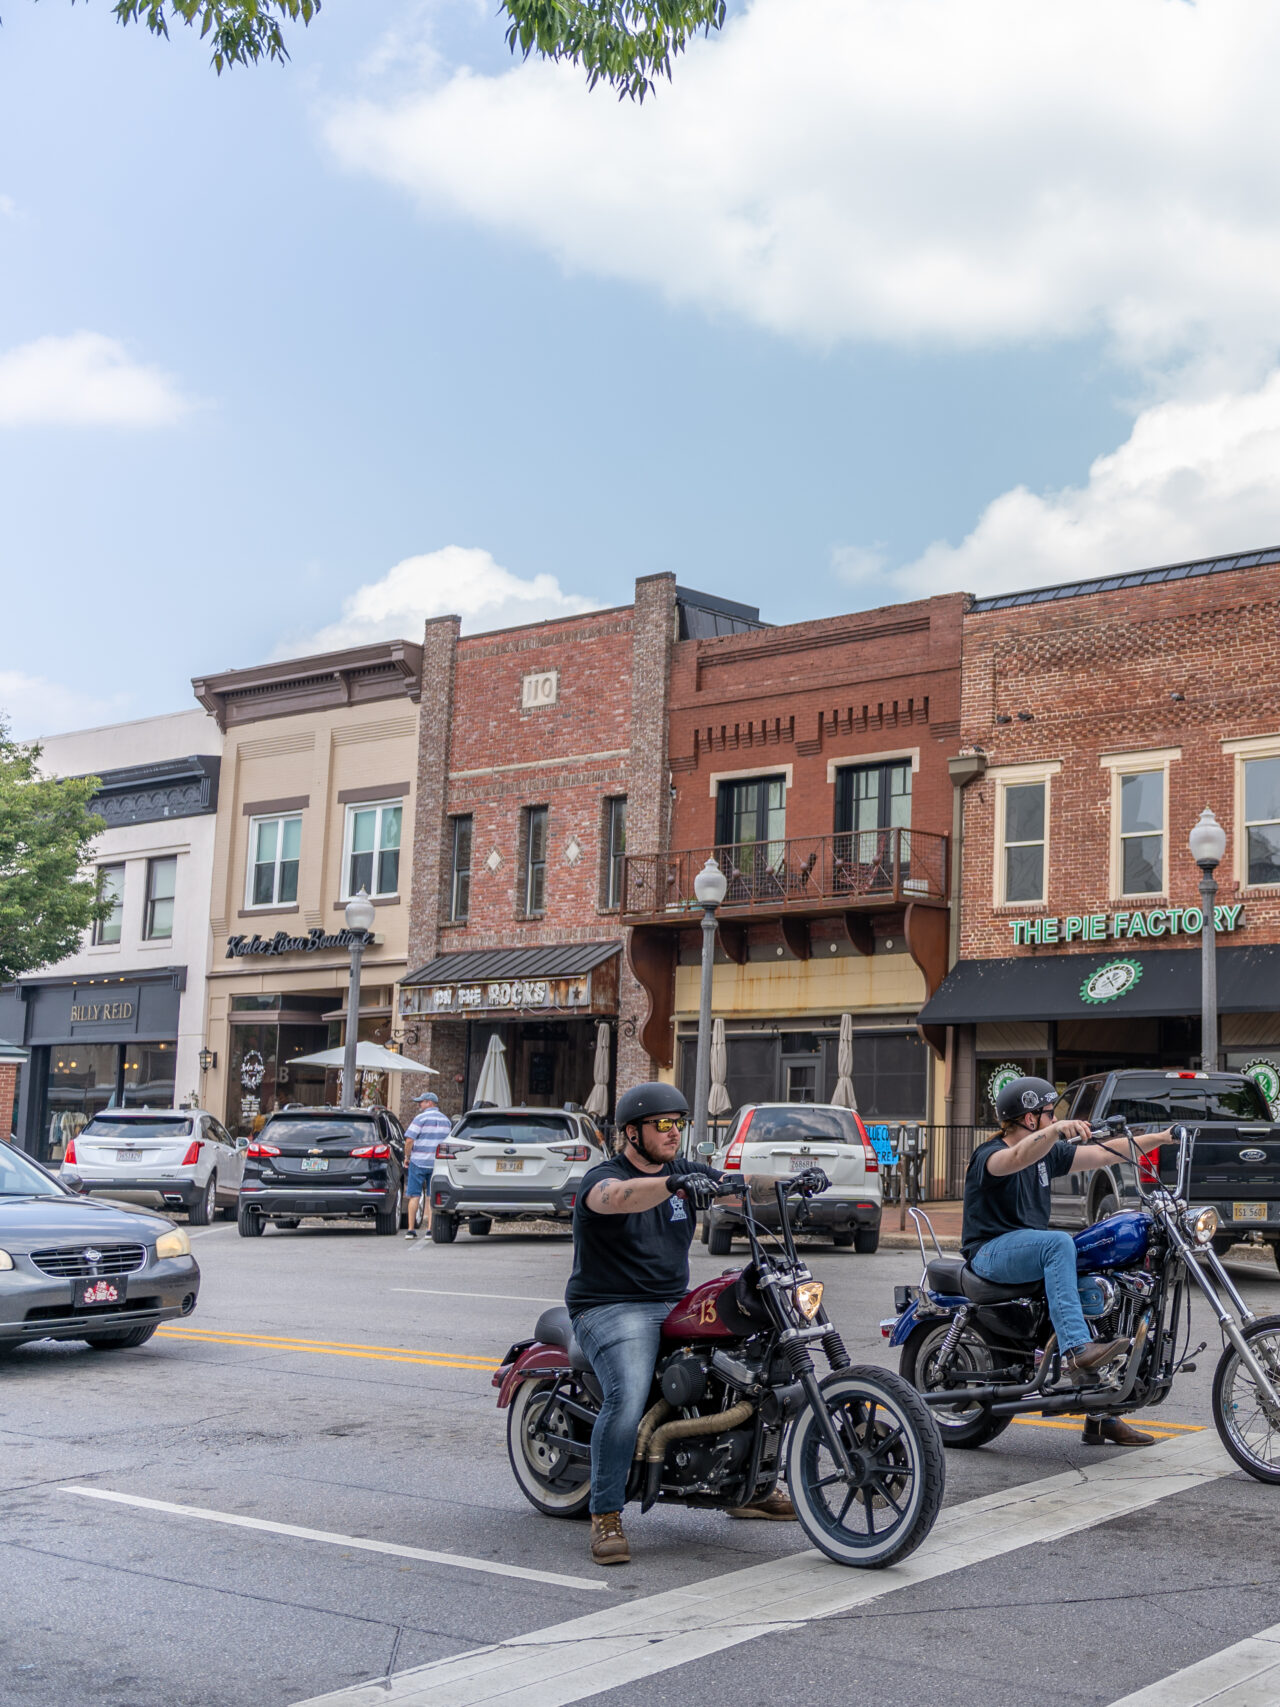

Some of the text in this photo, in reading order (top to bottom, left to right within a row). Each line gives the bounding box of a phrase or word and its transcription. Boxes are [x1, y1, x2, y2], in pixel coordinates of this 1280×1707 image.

[526, 677, 553, 701] 110
[1009, 903, 1244, 945] THE PIE FACTORY
[225, 928, 375, 958] Kodee Lissa Boutie
[434, 981, 547, 1005] ON THE ROCKS
[70, 1002, 132, 1021] BILLY REID
[699, 1299, 717, 1326] 13
